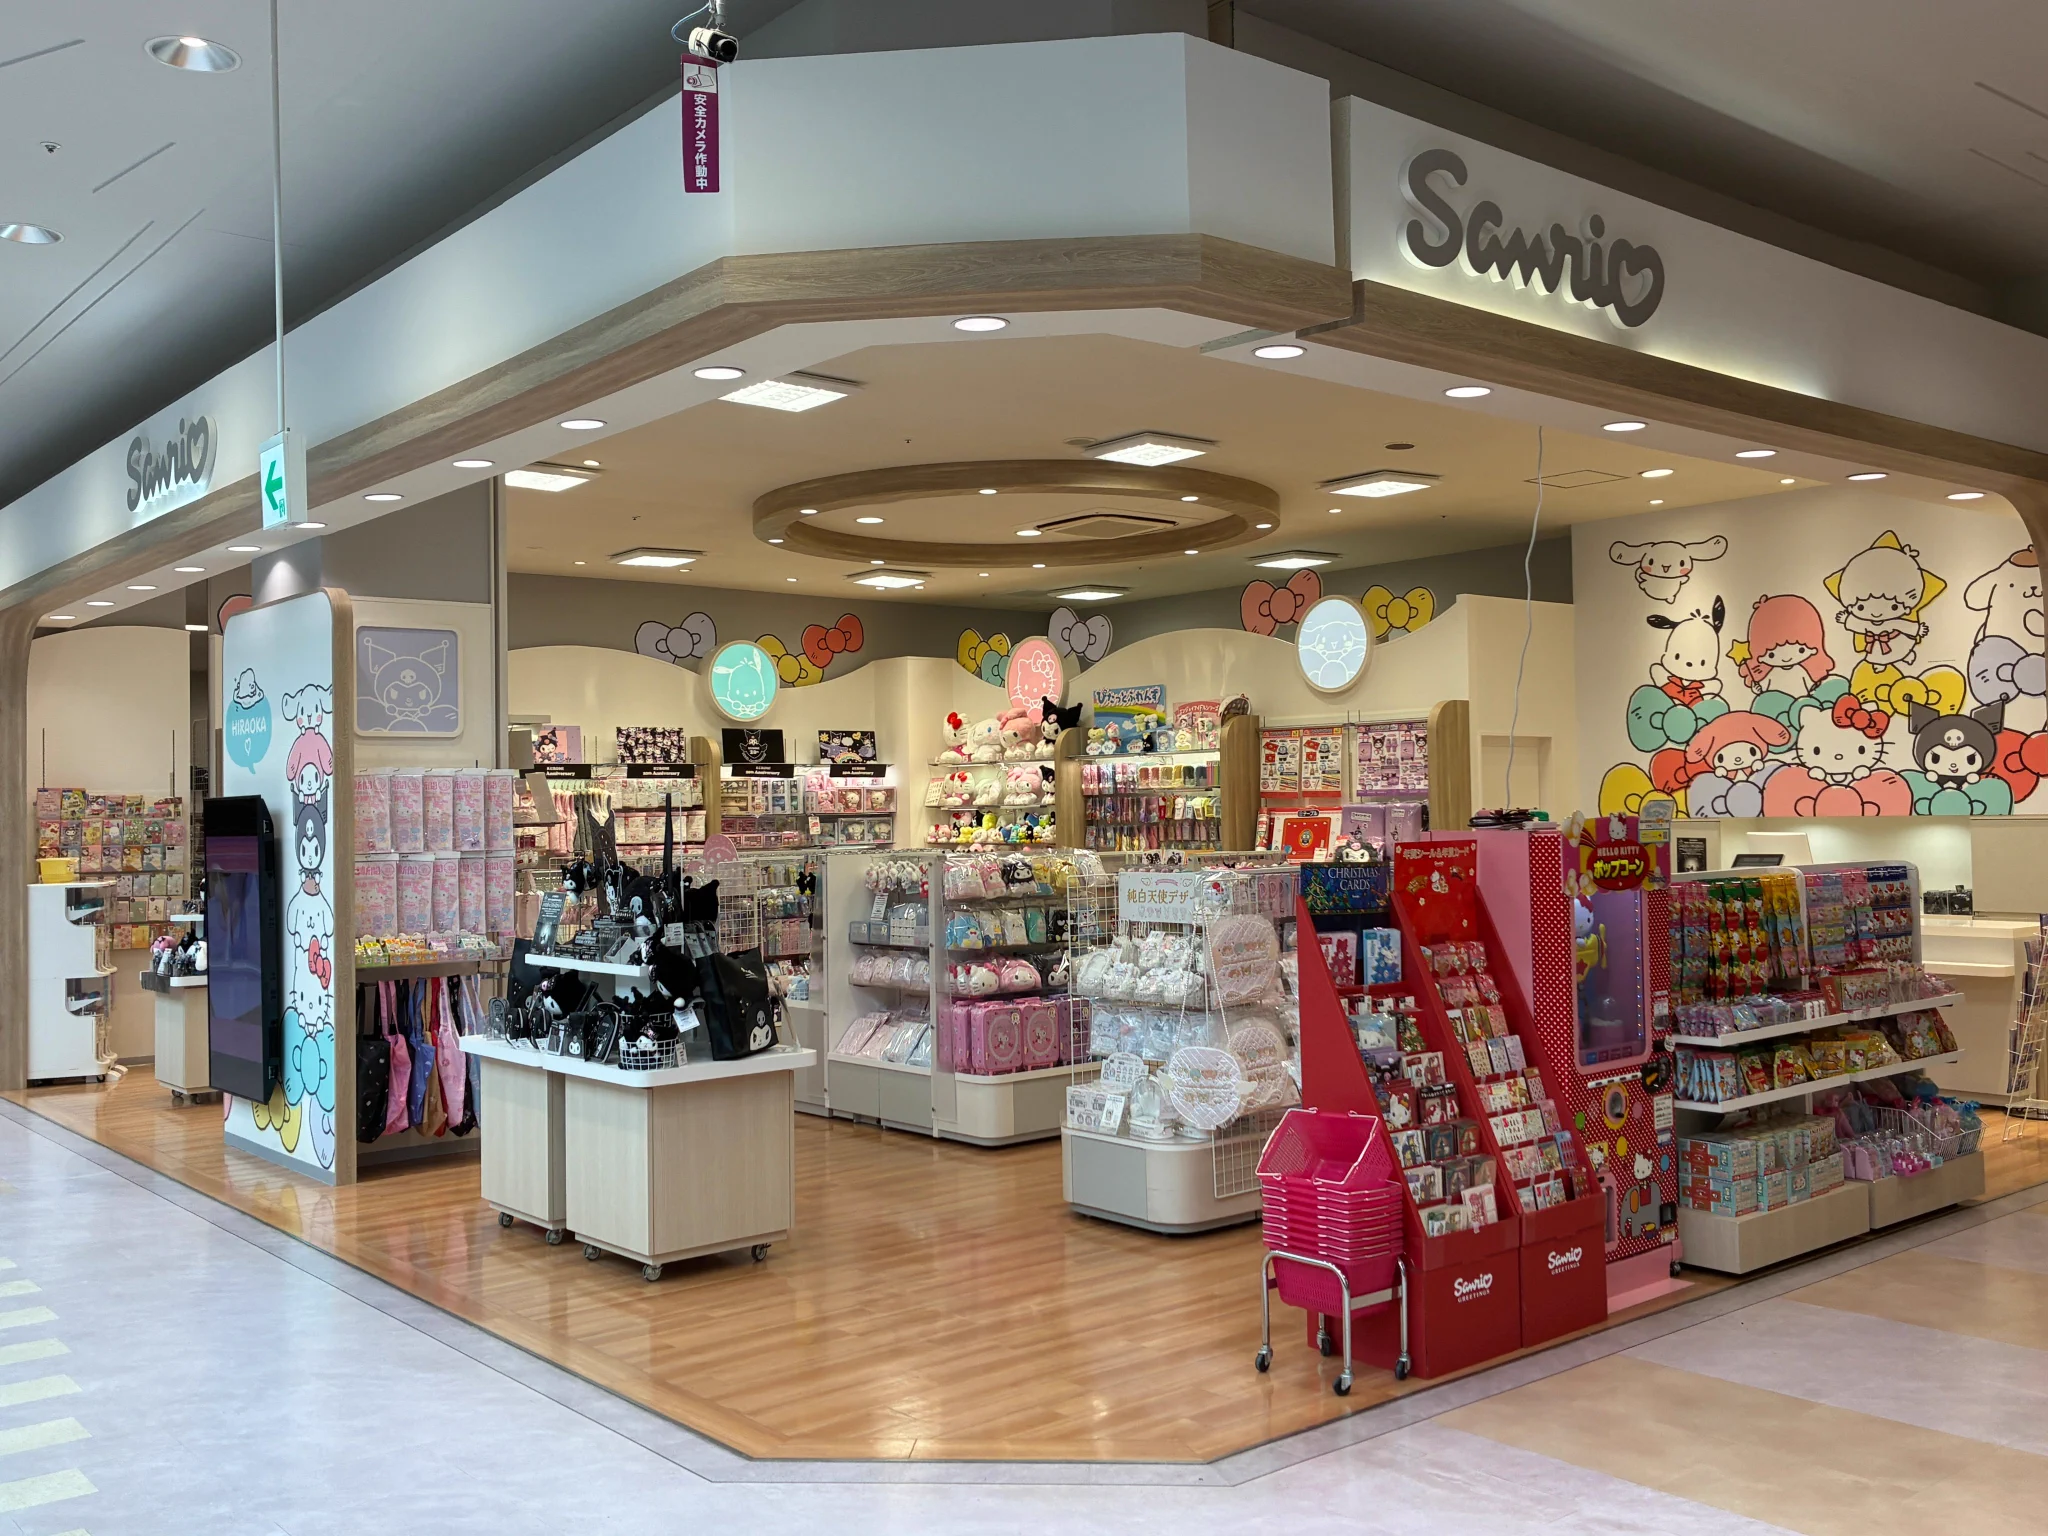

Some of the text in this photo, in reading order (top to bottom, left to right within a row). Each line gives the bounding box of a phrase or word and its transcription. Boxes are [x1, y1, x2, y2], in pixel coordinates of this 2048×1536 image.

[693, 93, 708, 190] 安全カメラ作動中
[1405, 148, 1666, 328] Sanrio
[126, 415, 212, 512] Sanrio
[1096, 686, 1161, 706] ぴたっとふれんず
[231, 716, 267, 737] HIRAOKA
[1597, 845, 1640, 857] HELLO KITTY
[1327, 867, 1379, 879] CHRISTMAS
[1593, 858, 1645, 879] ポップコーン
[1339, 879, 1371, 891] CARDS
[1127, 888, 1193, 904] 純白天使デザ
[1547, 1247, 1583, 1269] Sanrio
[1551, 1262, 1580, 1276] GREETINGS
[1453, 1272, 1493, 1297] Sanrio
[1457, 1289, 1490, 1303] GREETINGS
